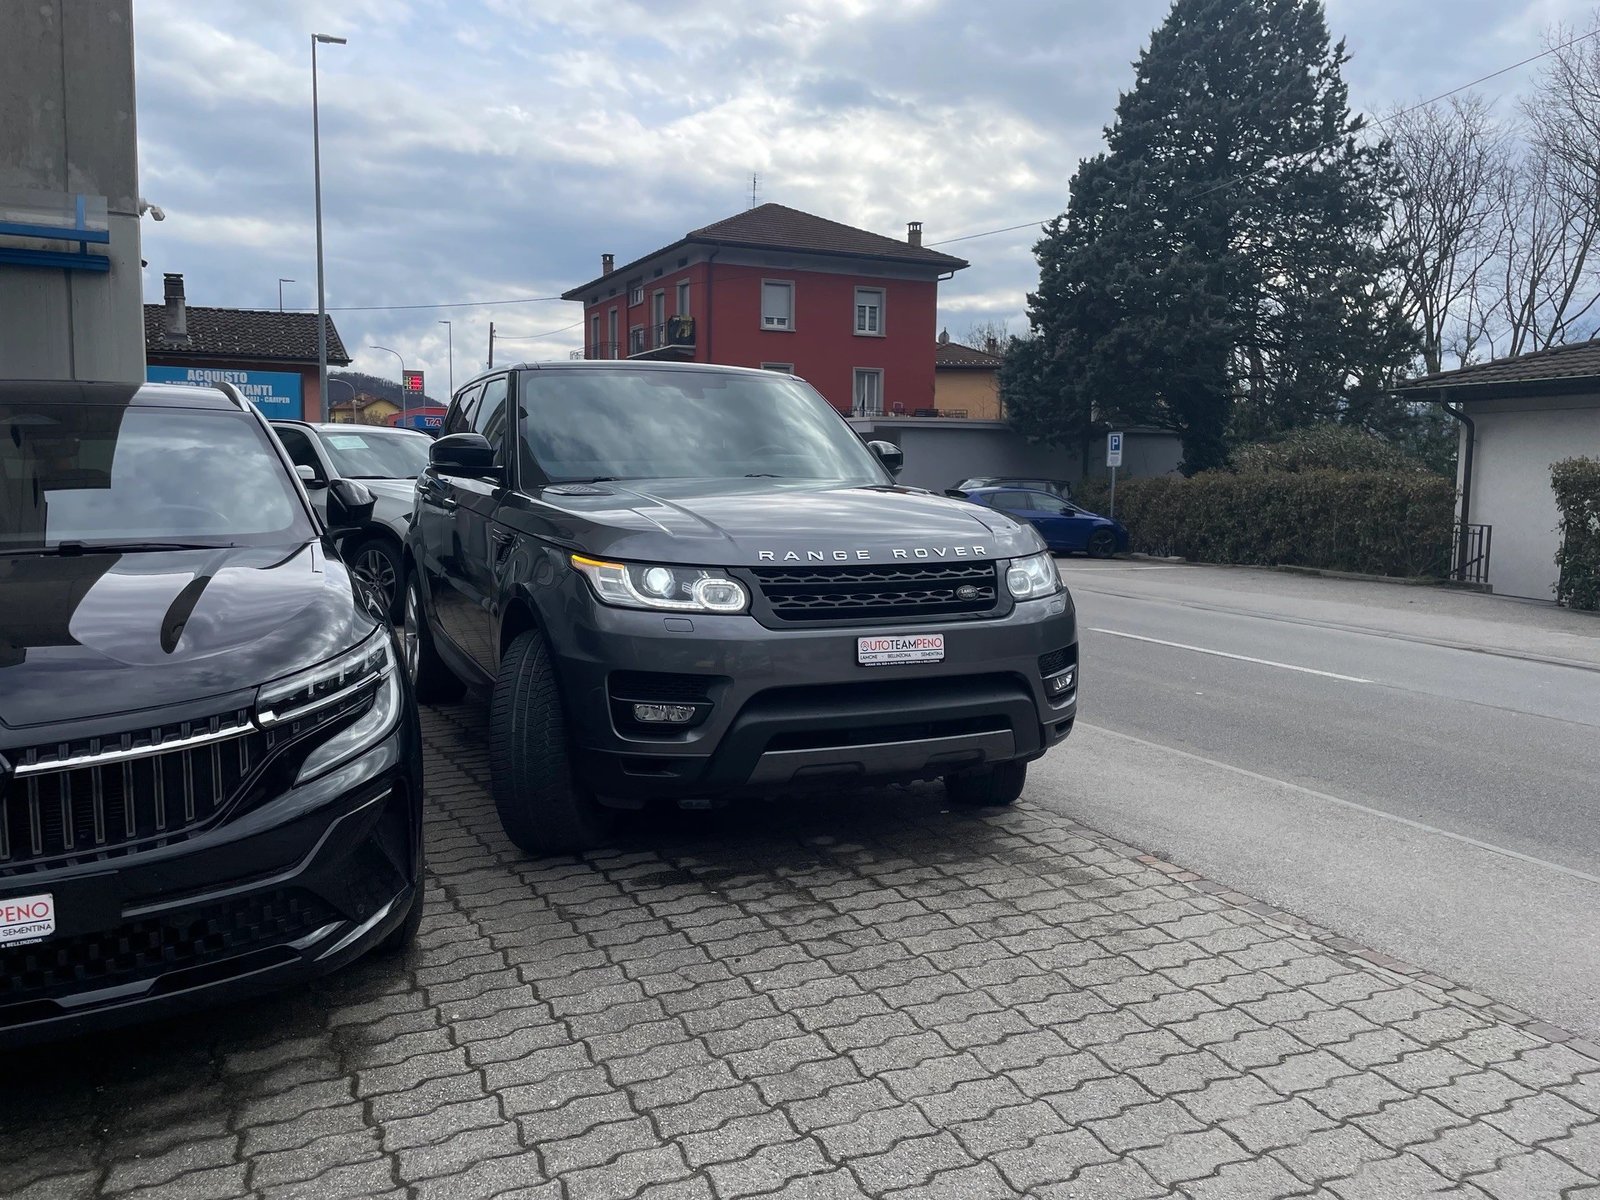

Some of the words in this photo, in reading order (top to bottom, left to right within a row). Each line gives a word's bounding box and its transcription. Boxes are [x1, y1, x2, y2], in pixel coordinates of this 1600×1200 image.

[187, 369, 248, 384] ACQUISTO
[264, 396, 290, 404] CAMPER
[1112, 436, 1119, 450] P
[758, 550, 870, 561] RANGE
[892, 545, 986, 559] ROVER
[2, 923, 52, 937] SEMENTINA
